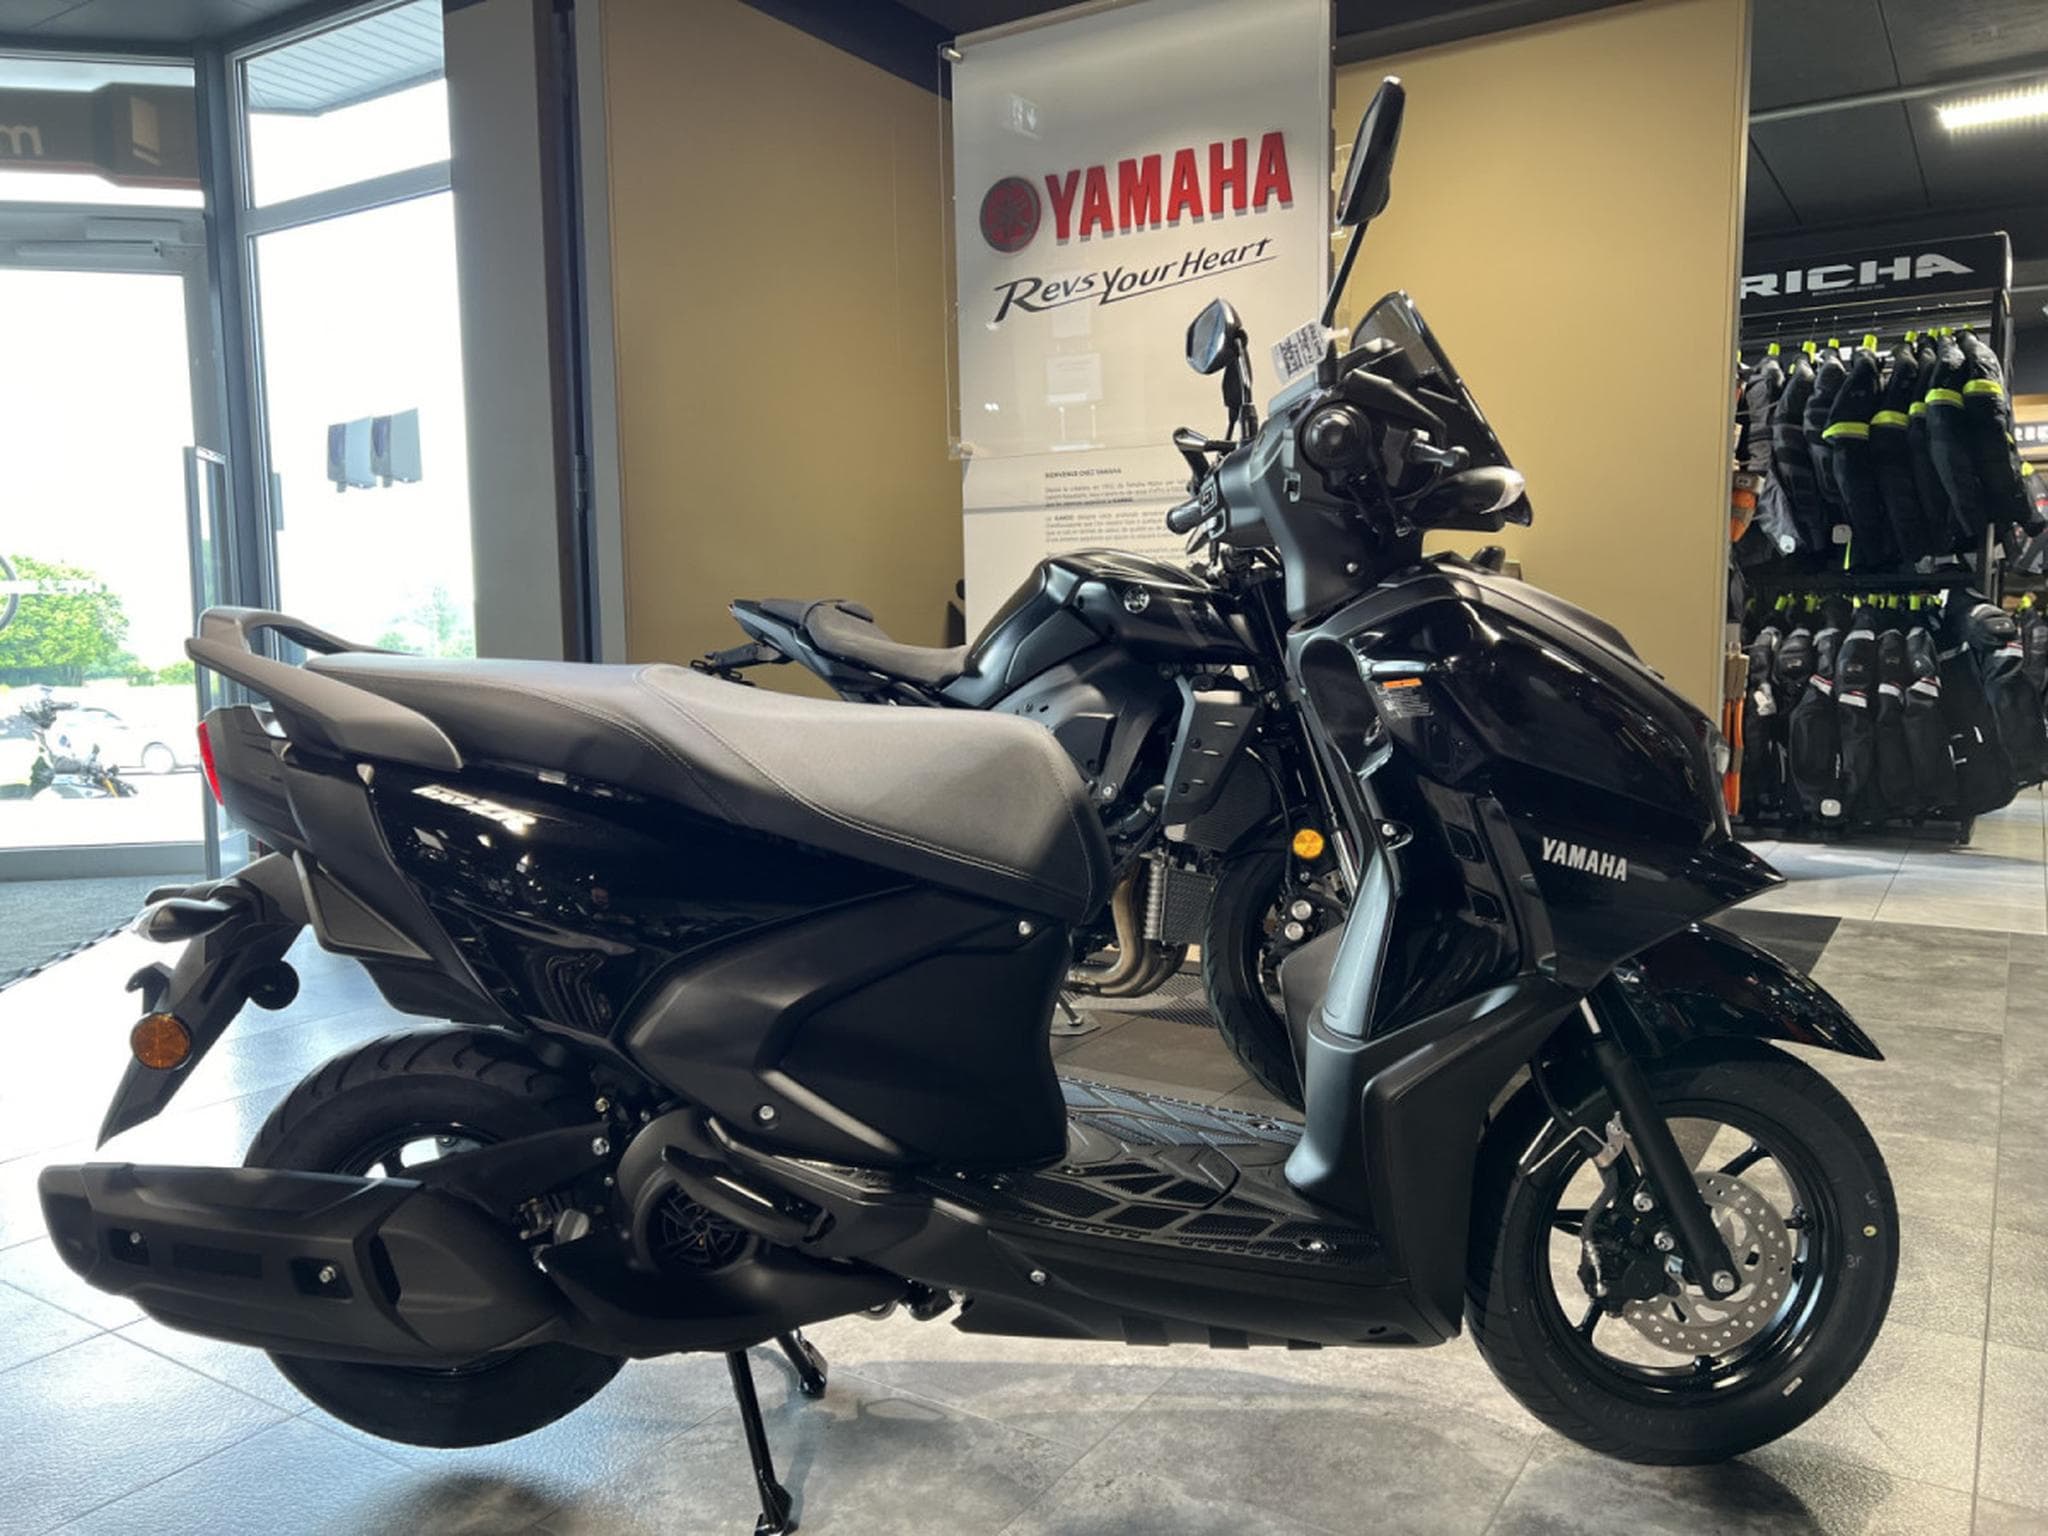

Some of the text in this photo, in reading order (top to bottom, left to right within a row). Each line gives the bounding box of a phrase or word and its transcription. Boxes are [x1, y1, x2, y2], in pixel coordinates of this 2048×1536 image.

[1045, 131, 1293, 241] YAMAHA
[994, 237, 1274, 323] Revs Your Heart
[1741, 253, 1976, 299] RICHA
[1541, 836, 1629, 882] YAMAHA
